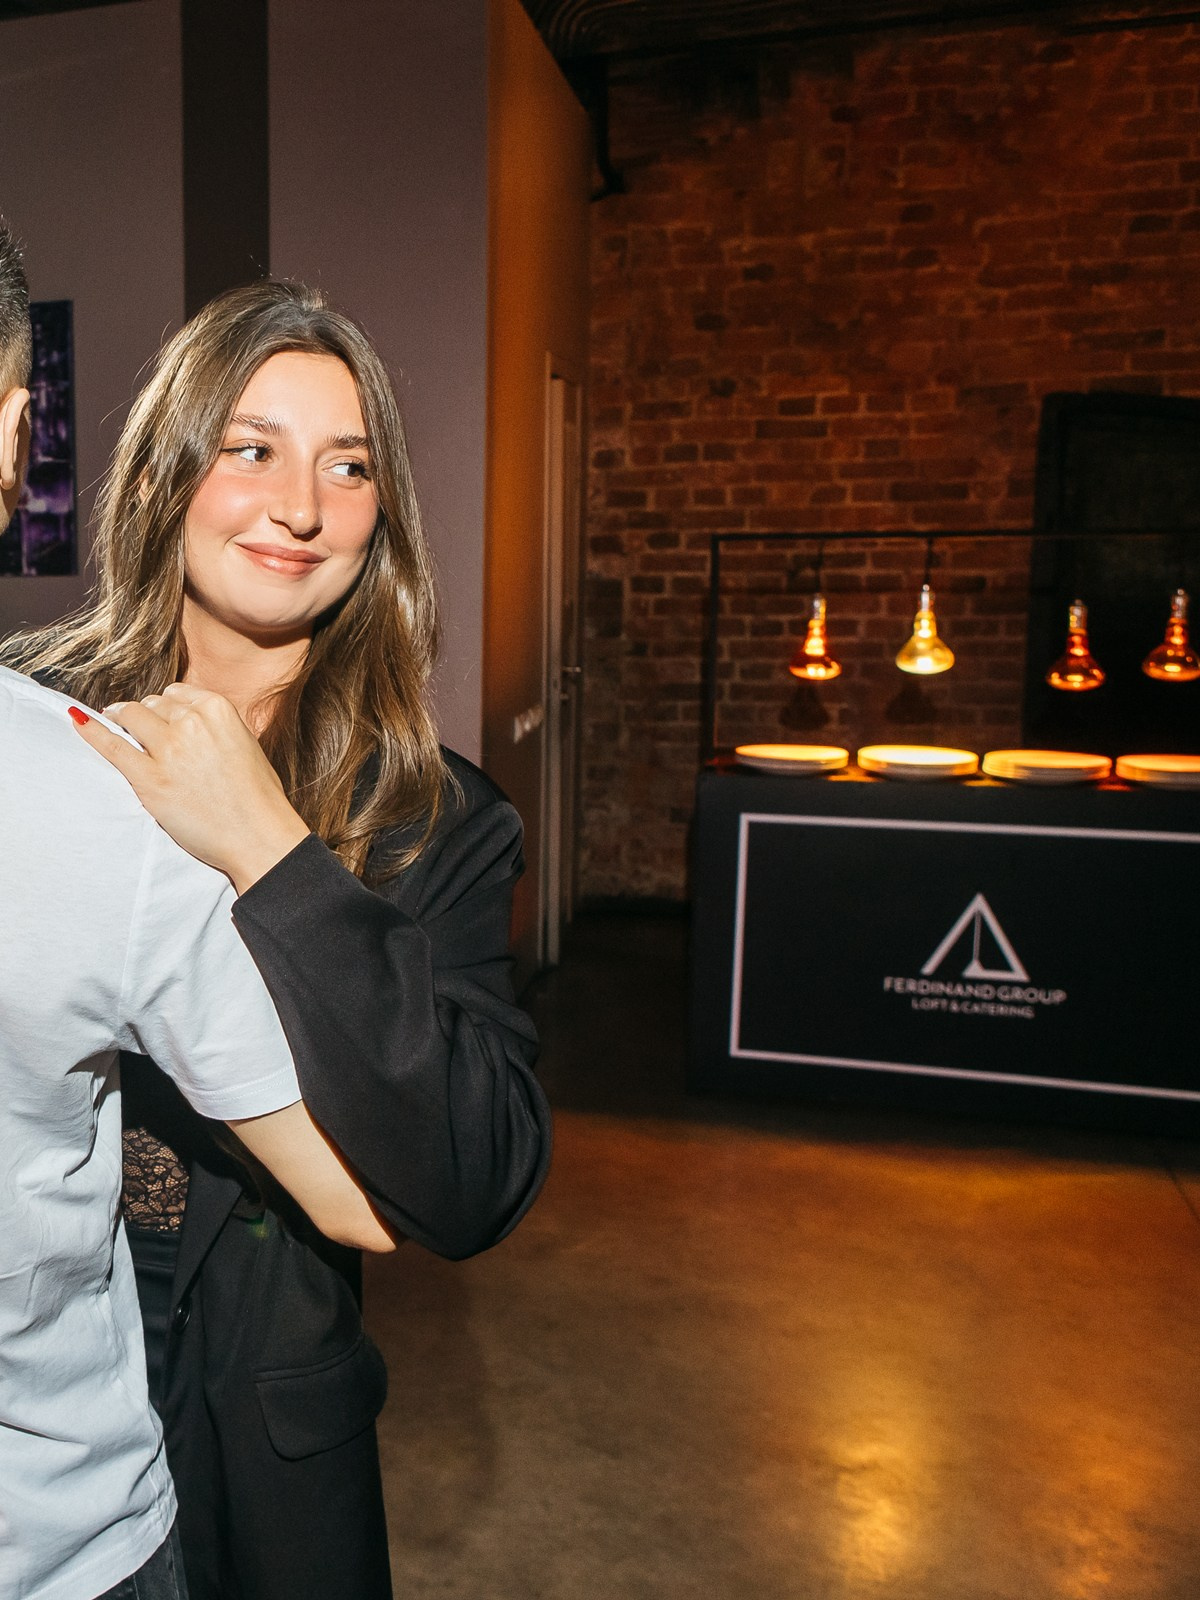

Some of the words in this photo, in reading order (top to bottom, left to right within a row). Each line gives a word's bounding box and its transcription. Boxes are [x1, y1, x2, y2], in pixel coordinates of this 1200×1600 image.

[911, 997, 948, 1010] LOFT
[949, 999, 960, 1013] &
[960, 1000, 1035, 1019] CATERING
